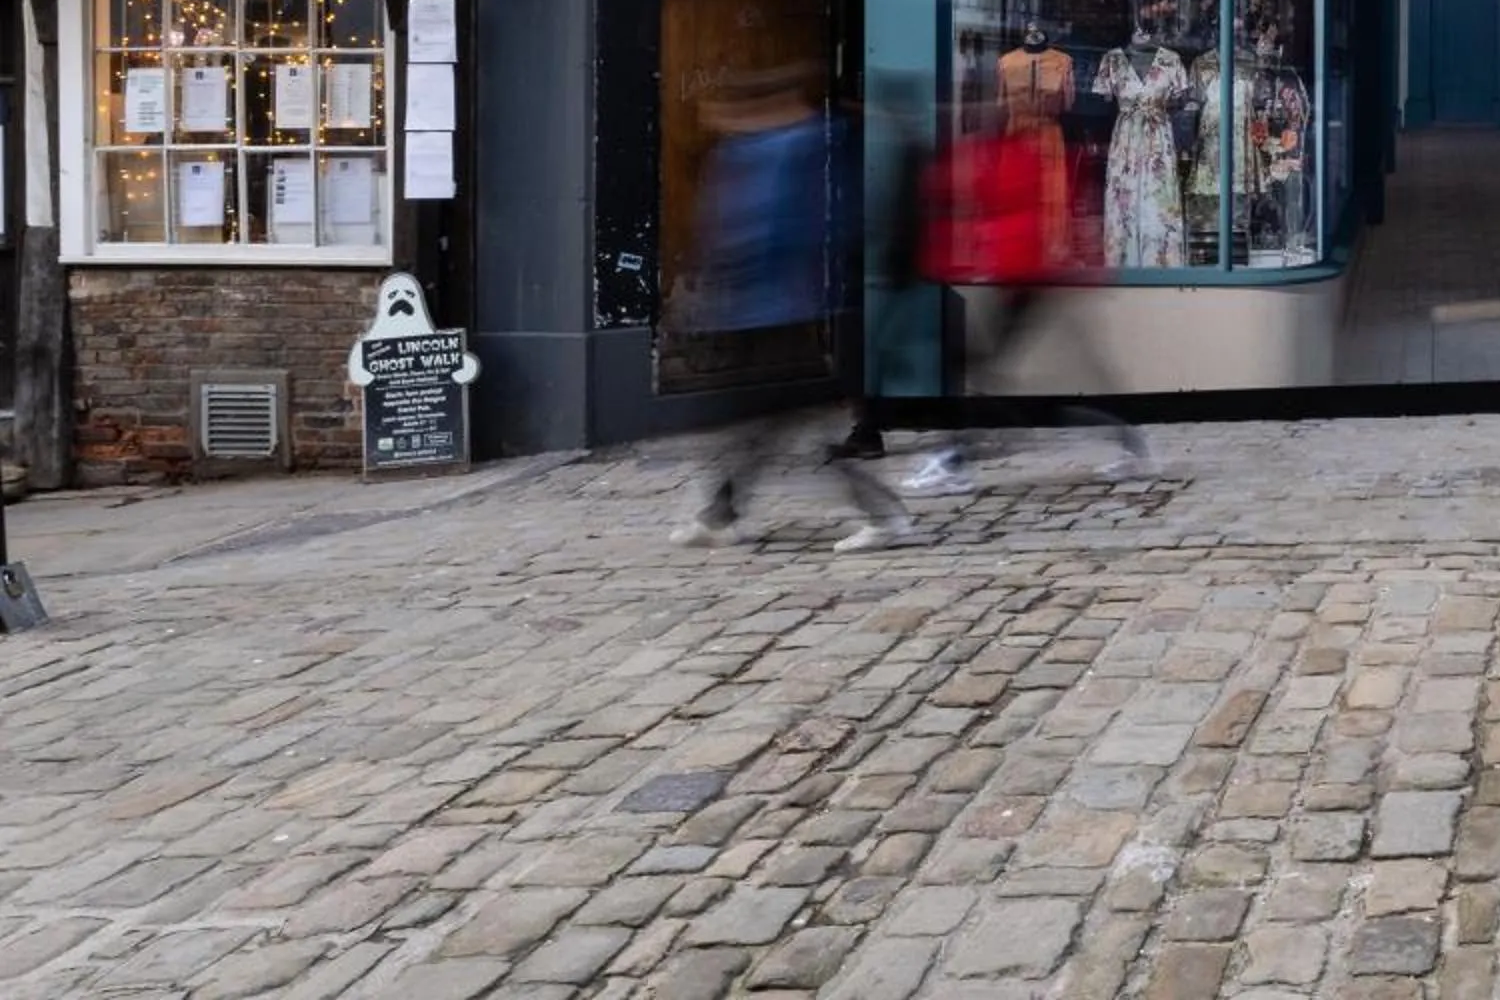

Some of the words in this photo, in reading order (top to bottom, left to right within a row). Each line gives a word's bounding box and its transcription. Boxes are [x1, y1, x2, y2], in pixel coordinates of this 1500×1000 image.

[397, 336, 459, 355] LINCOLN
[369, 357, 415, 373] GHOST
[420, 352, 461, 368] WALK
